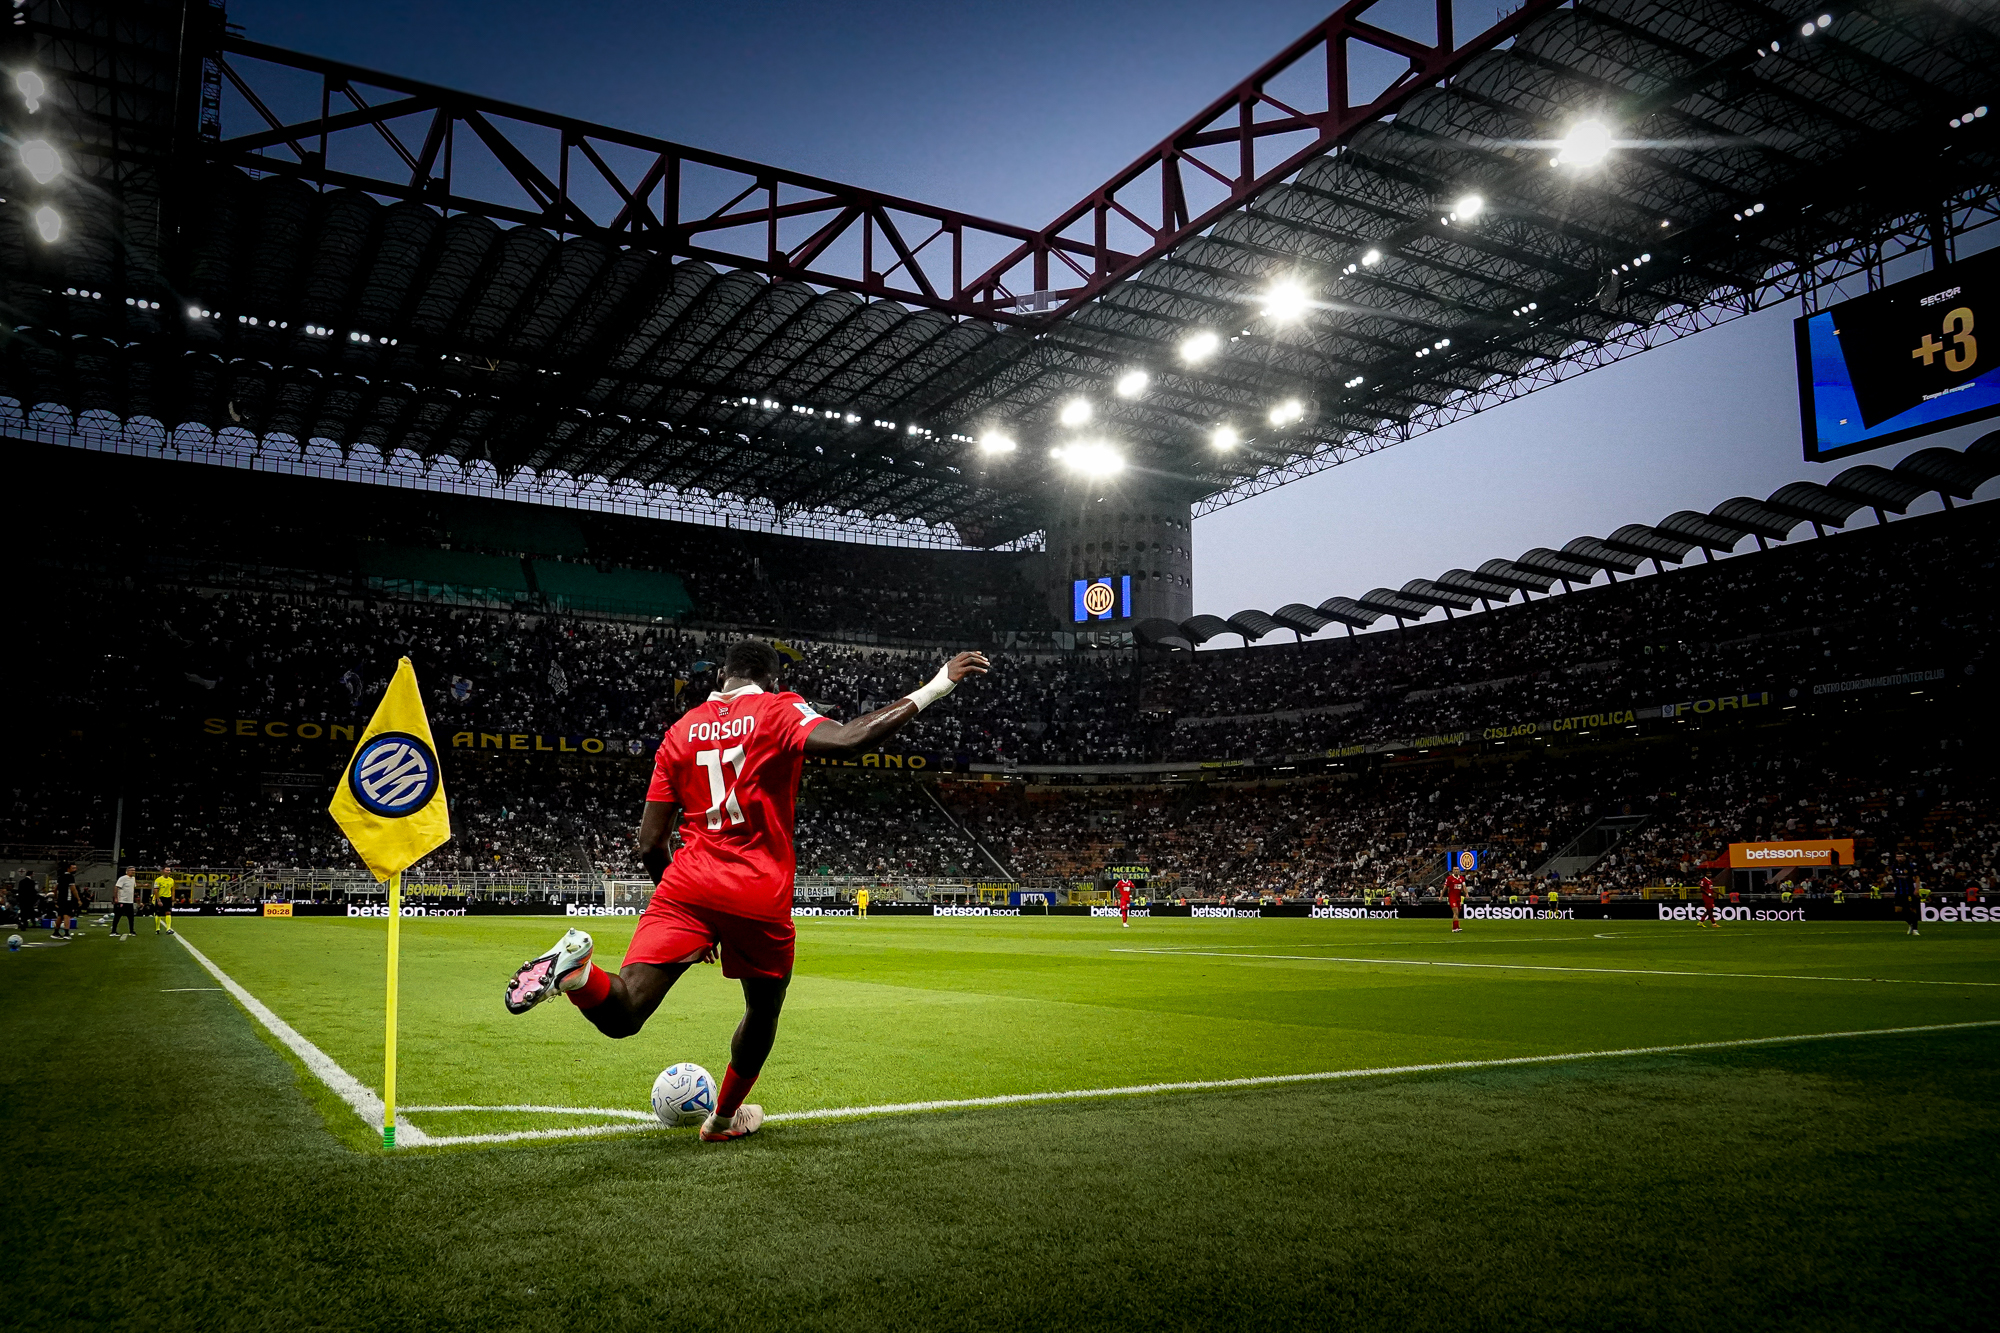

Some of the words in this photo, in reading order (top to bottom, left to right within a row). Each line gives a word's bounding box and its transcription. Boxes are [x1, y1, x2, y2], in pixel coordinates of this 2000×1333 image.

[1920, 286, 1962, 306] SECTOR
[1911, 306, 1978, 373] +3
[1813, 682, 1840, 695] CENTRO
[1902, 671, 1924, 684] INTER
[1924, 668, 1945, 681] CLUB
[203, 717, 366, 741] SECON
[688, 715, 755, 742] FORSON
[1482, 722, 1537, 740] CISLAGO
[1552, 709, 1635, 732] CATTOLICA
[450, 731, 604, 754] ANELLO
[1745, 847, 1832, 860] betsson.spor
[347, 903, 467, 917] betson.sport
